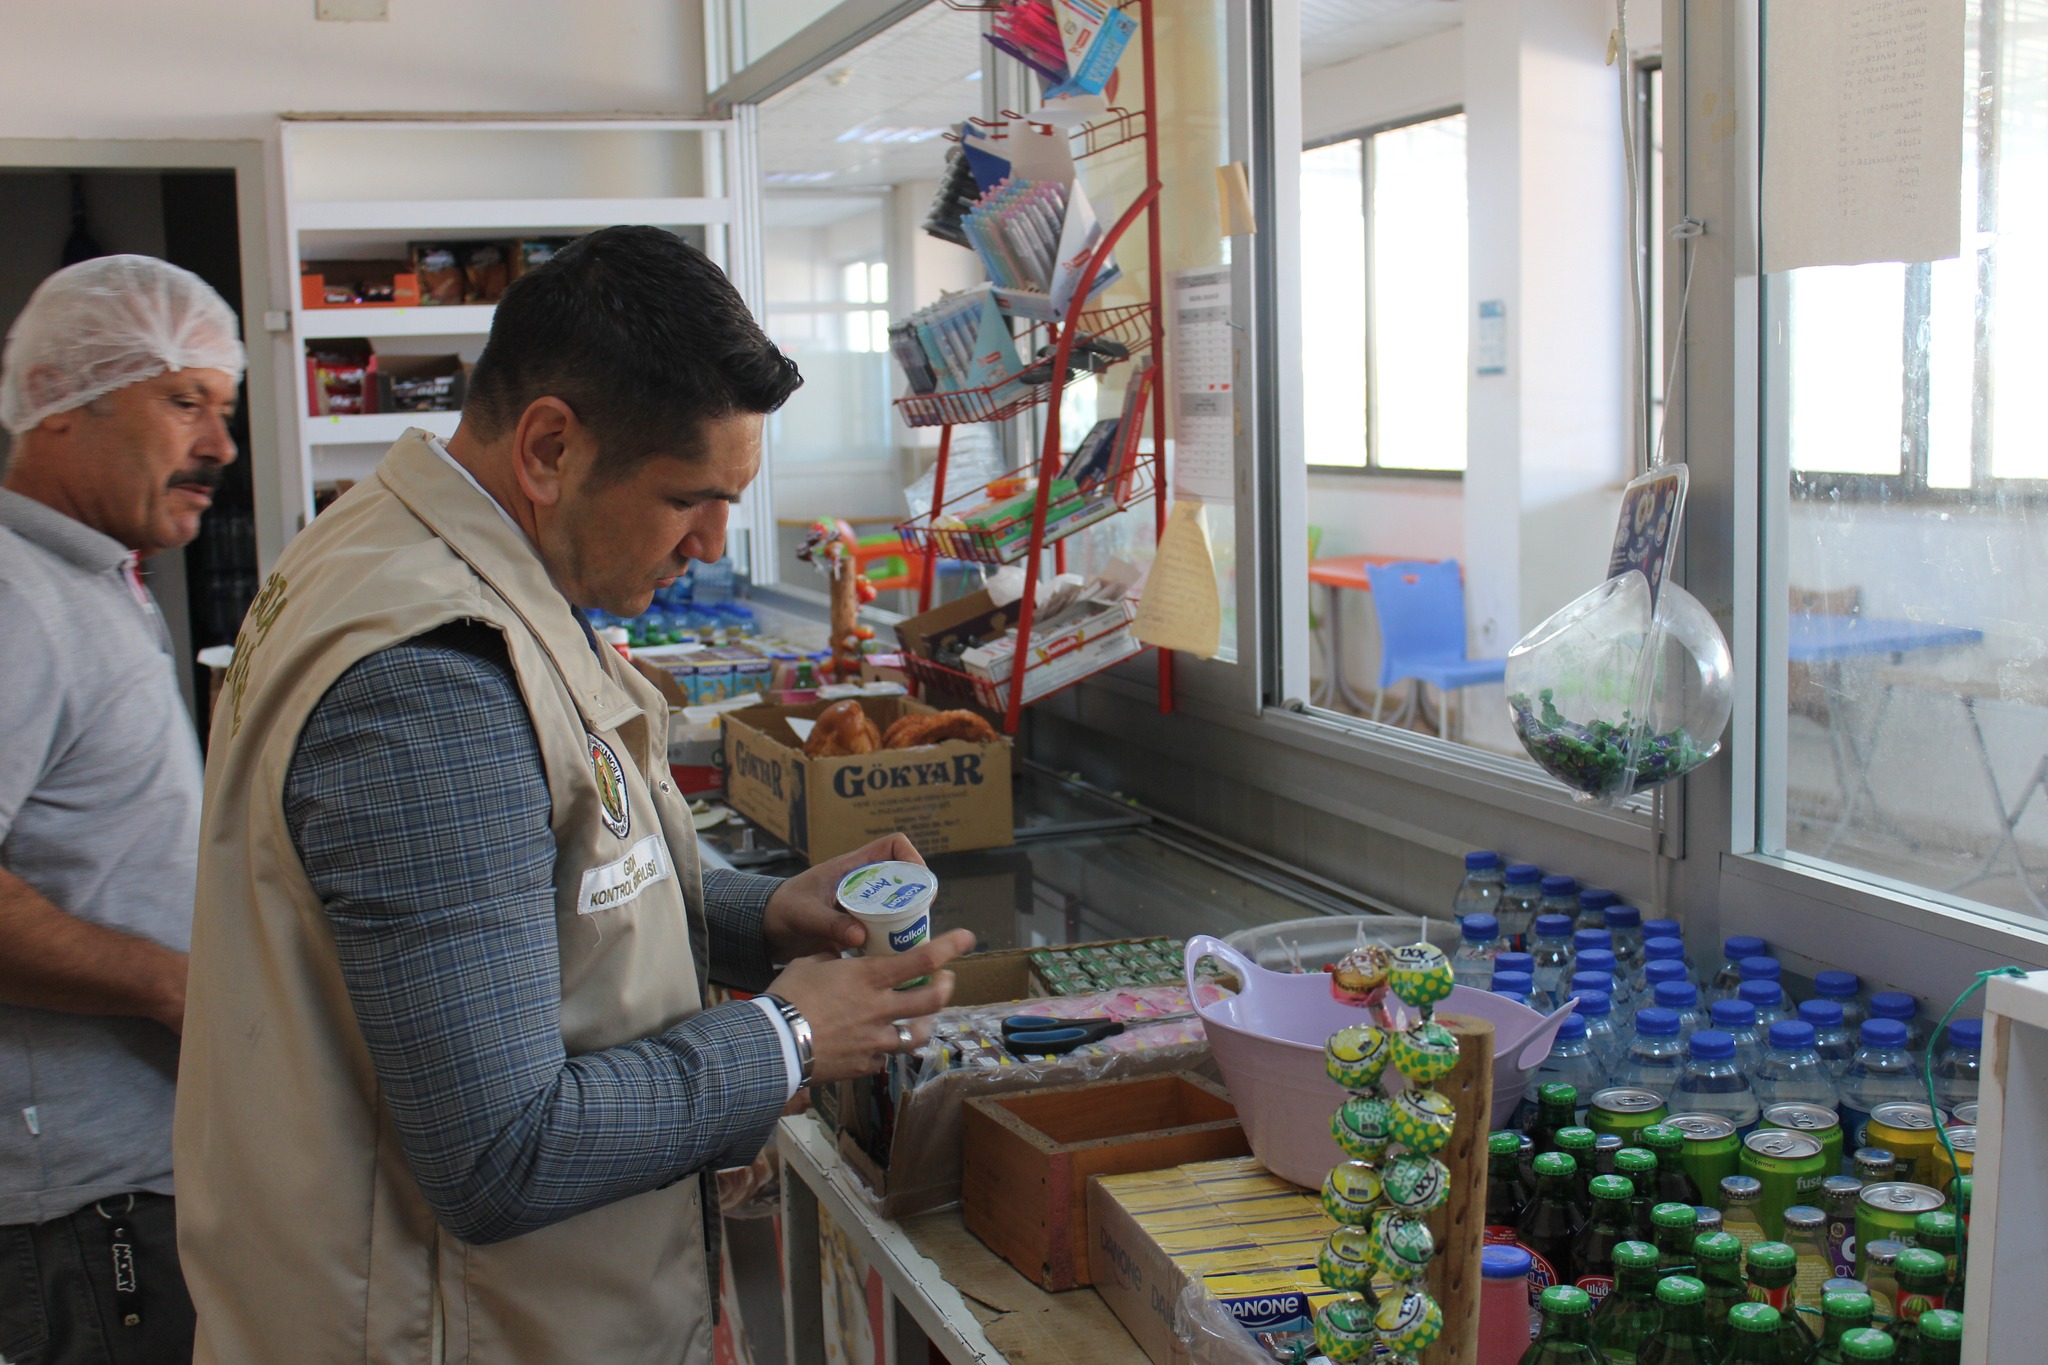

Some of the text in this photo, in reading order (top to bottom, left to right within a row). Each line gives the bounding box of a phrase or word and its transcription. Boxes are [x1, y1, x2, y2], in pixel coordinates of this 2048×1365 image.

[833, 753, 984, 799] GÖKYAR
[590, 880, 634, 907] KONTROL
[894, 923, 926, 945] Kalkan
[1796, 1176, 1822, 1190] fuse
[1889, 1230, 1919, 1247] fus
